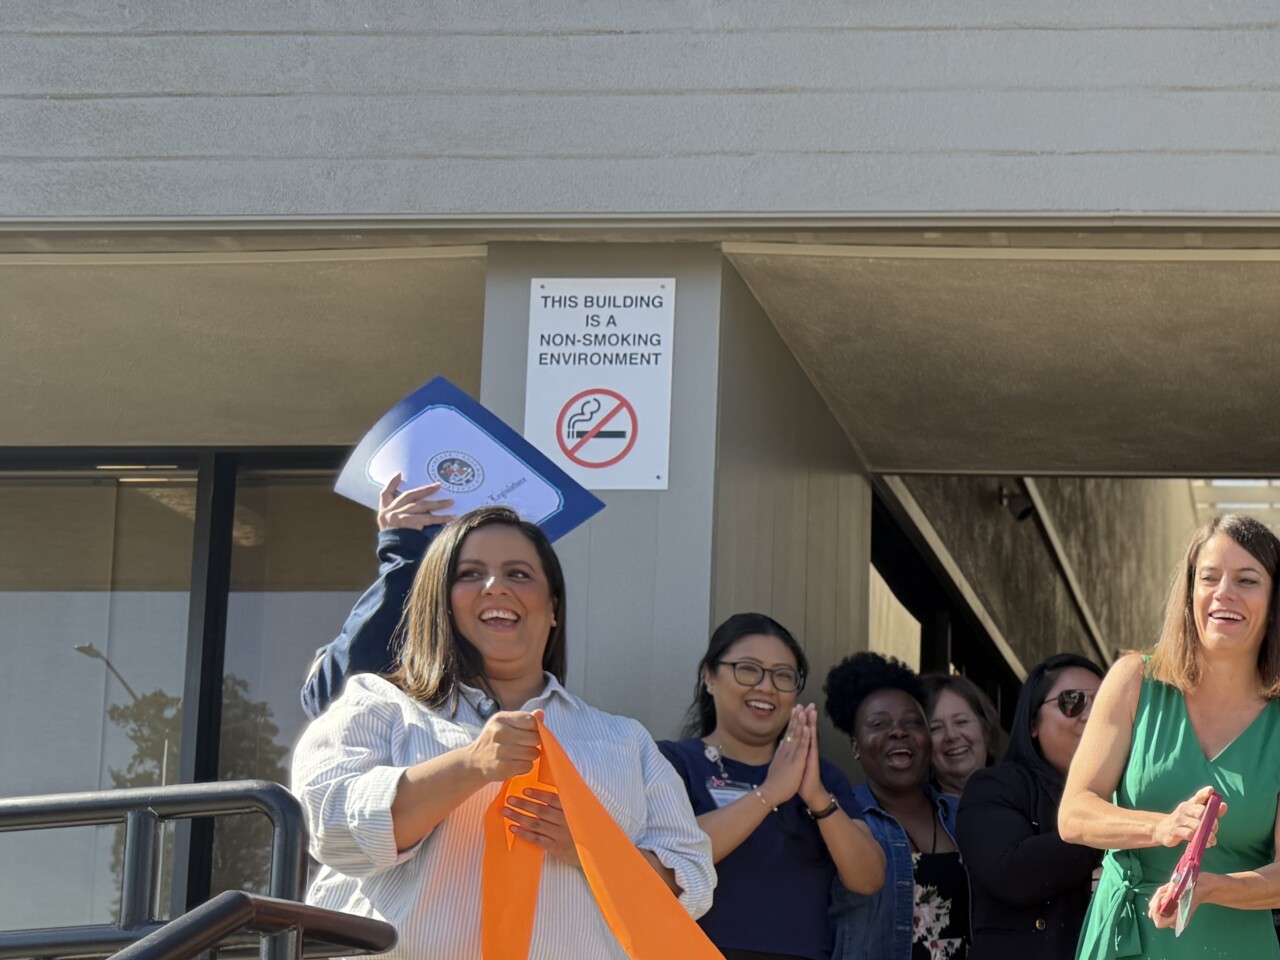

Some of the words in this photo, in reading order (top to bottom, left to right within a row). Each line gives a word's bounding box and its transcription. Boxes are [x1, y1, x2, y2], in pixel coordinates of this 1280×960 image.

[541, 295, 578, 308] THIS
[584, 295, 664, 308] BUILDING
[585, 314, 601, 327] IS
[606, 314, 617, 327] A
[540, 333, 662, 347] NON-SMOKING
[538, 352, 662, 366] ENVIRONMENT
